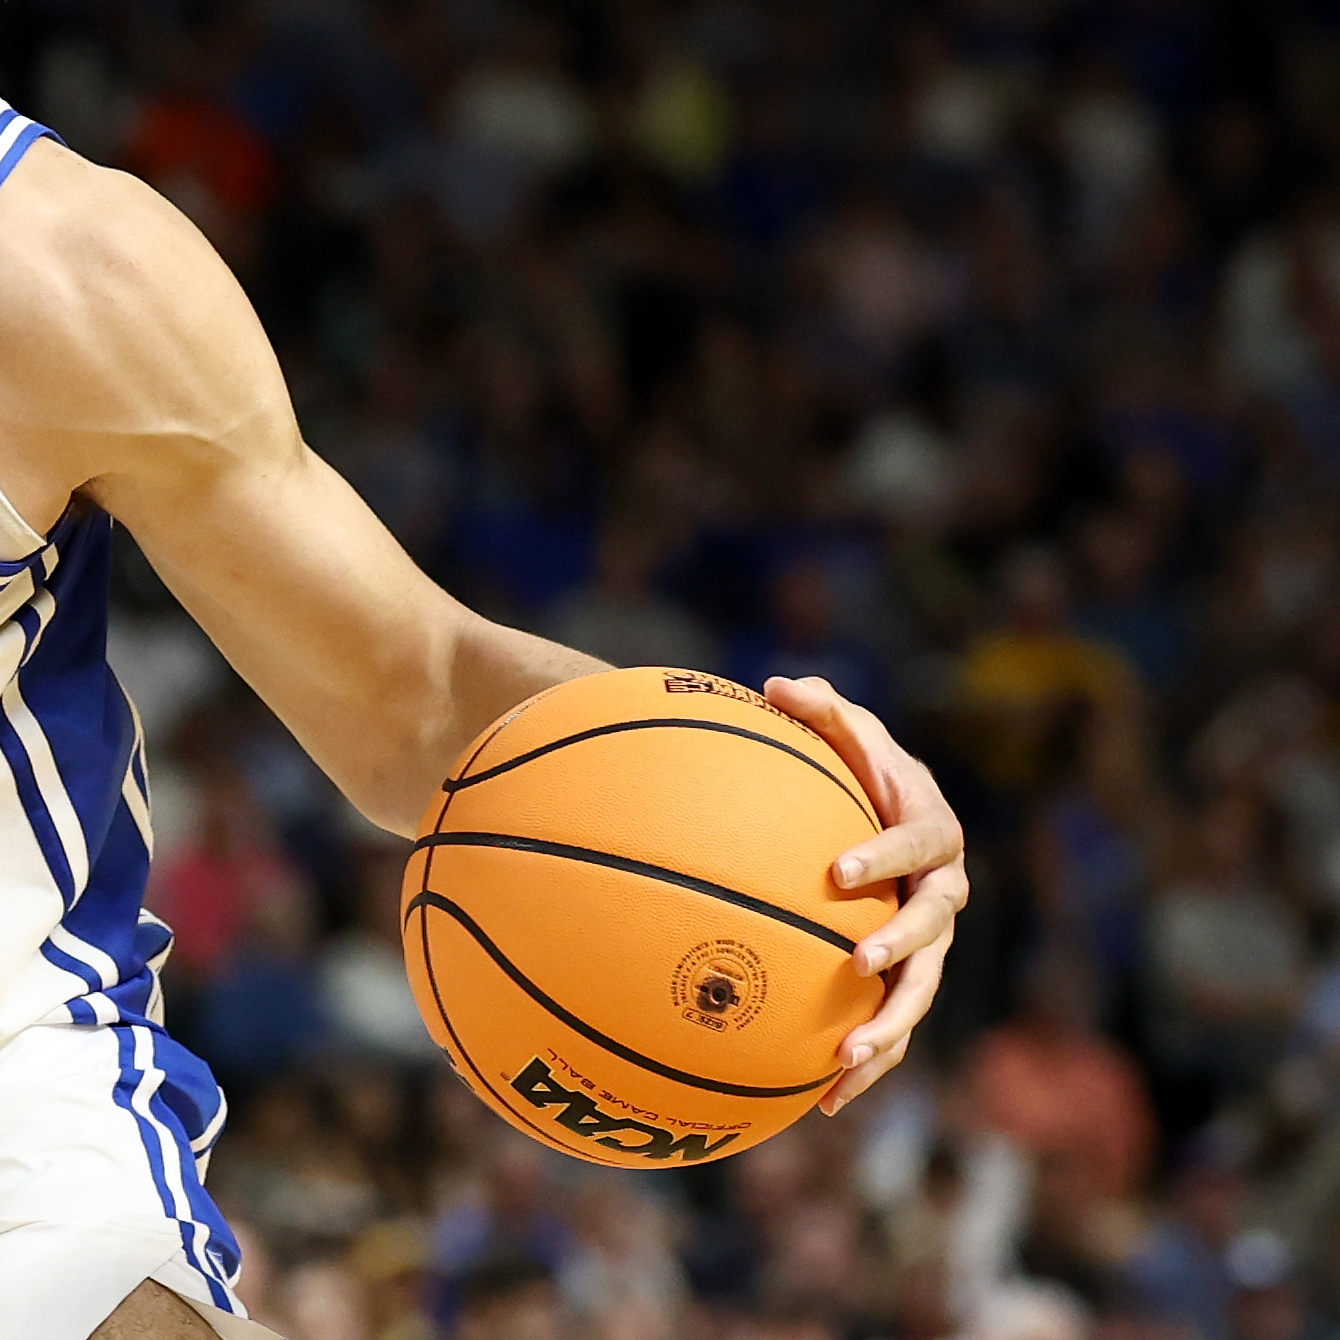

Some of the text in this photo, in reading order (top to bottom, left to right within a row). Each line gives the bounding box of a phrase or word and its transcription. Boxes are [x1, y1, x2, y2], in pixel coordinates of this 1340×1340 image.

[509, 1055, 743, 1161] NCAA
[547, 1047, 752, 1131] OFFICIAL GAME BALL
